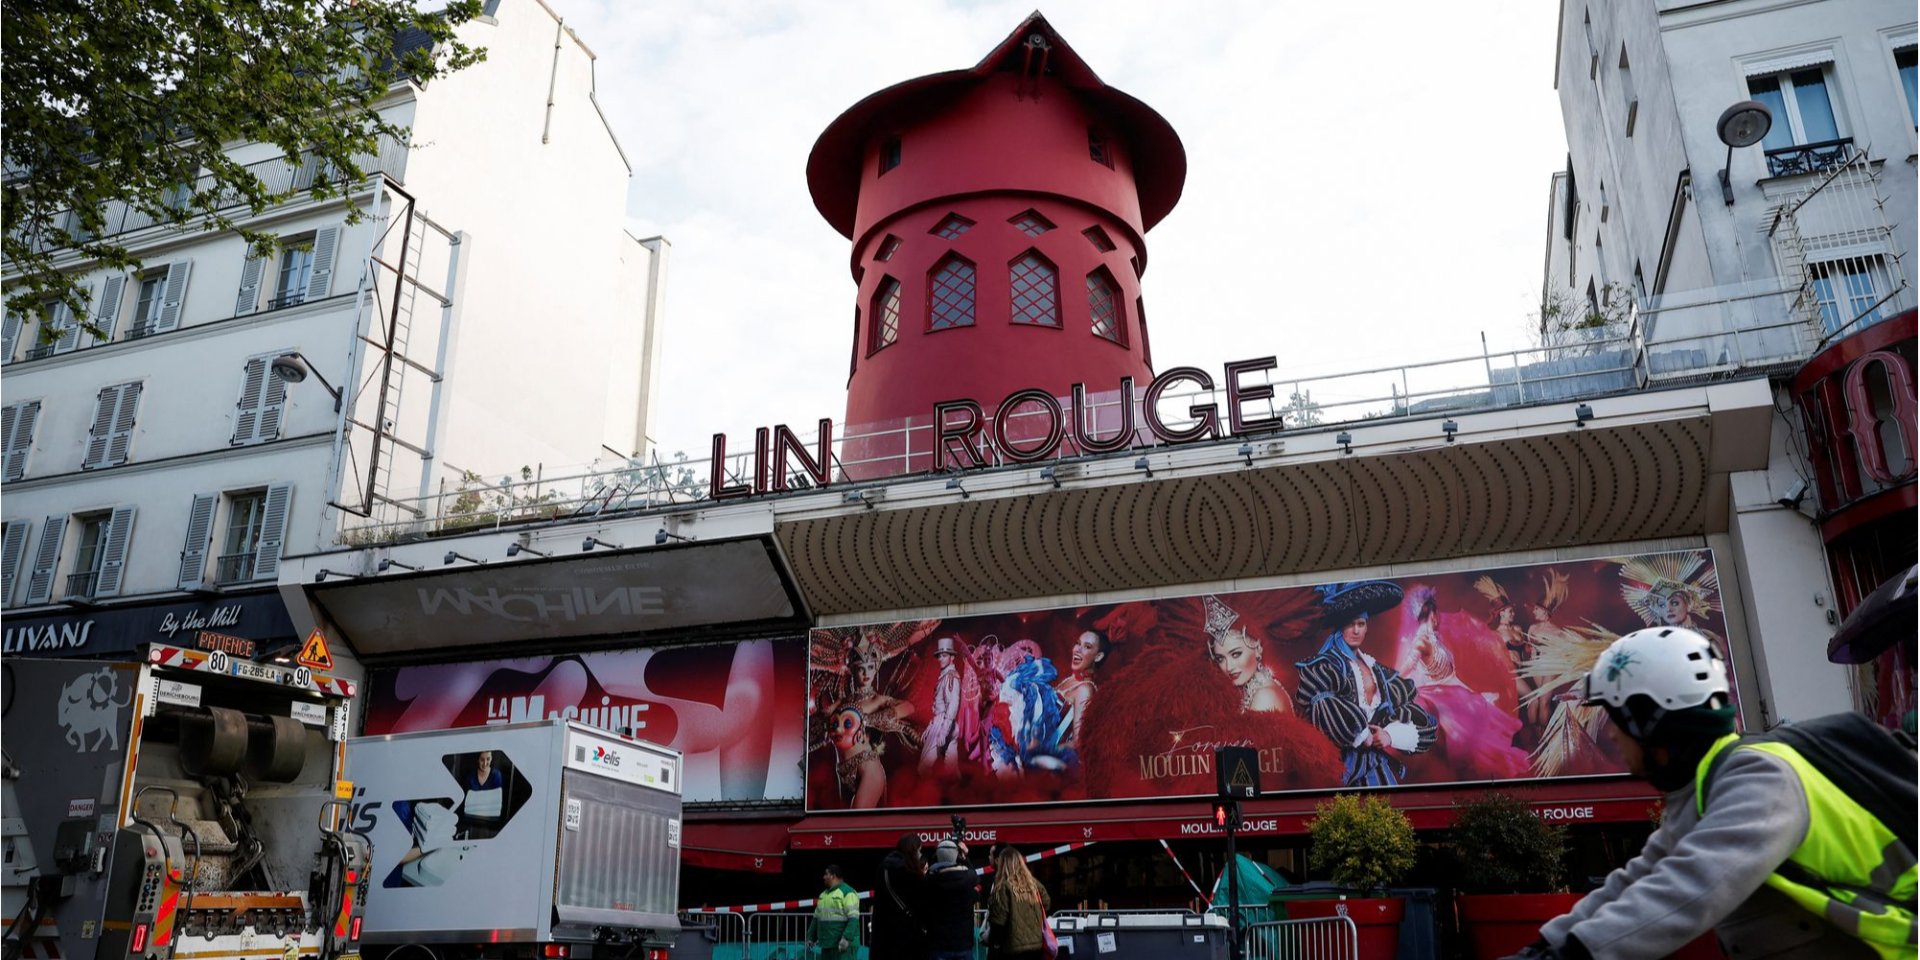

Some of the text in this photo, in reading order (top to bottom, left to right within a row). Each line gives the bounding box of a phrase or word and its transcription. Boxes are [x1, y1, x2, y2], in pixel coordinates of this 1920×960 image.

[710, 356, 1284, 501] LIN ROUGE
[159, 604, 242, 638] By the Mill
[3, 620, 95, 653] LIVANS
[199, 631, 253, 657] PATIENCE
[210, 652, 226, 671] 80
[296, 668, 310, 686] 90
[159, 690, 199, 701] DERICHEBOURG
[488, 697, 507, 717] LA
[340, 703, 348, 740] 6416
[1160, 725, 1254, 761] Forever
[603, 750, 621, 767] elis
[1139, 754, 1210, 780] MOULIN
[69, 803, 93, 812] DANGER
[1543, 806, 1594, 820] ROUGE
[1233, 820, 1277, 832] OUGE
[917, 831, 953, 842] OULIN
